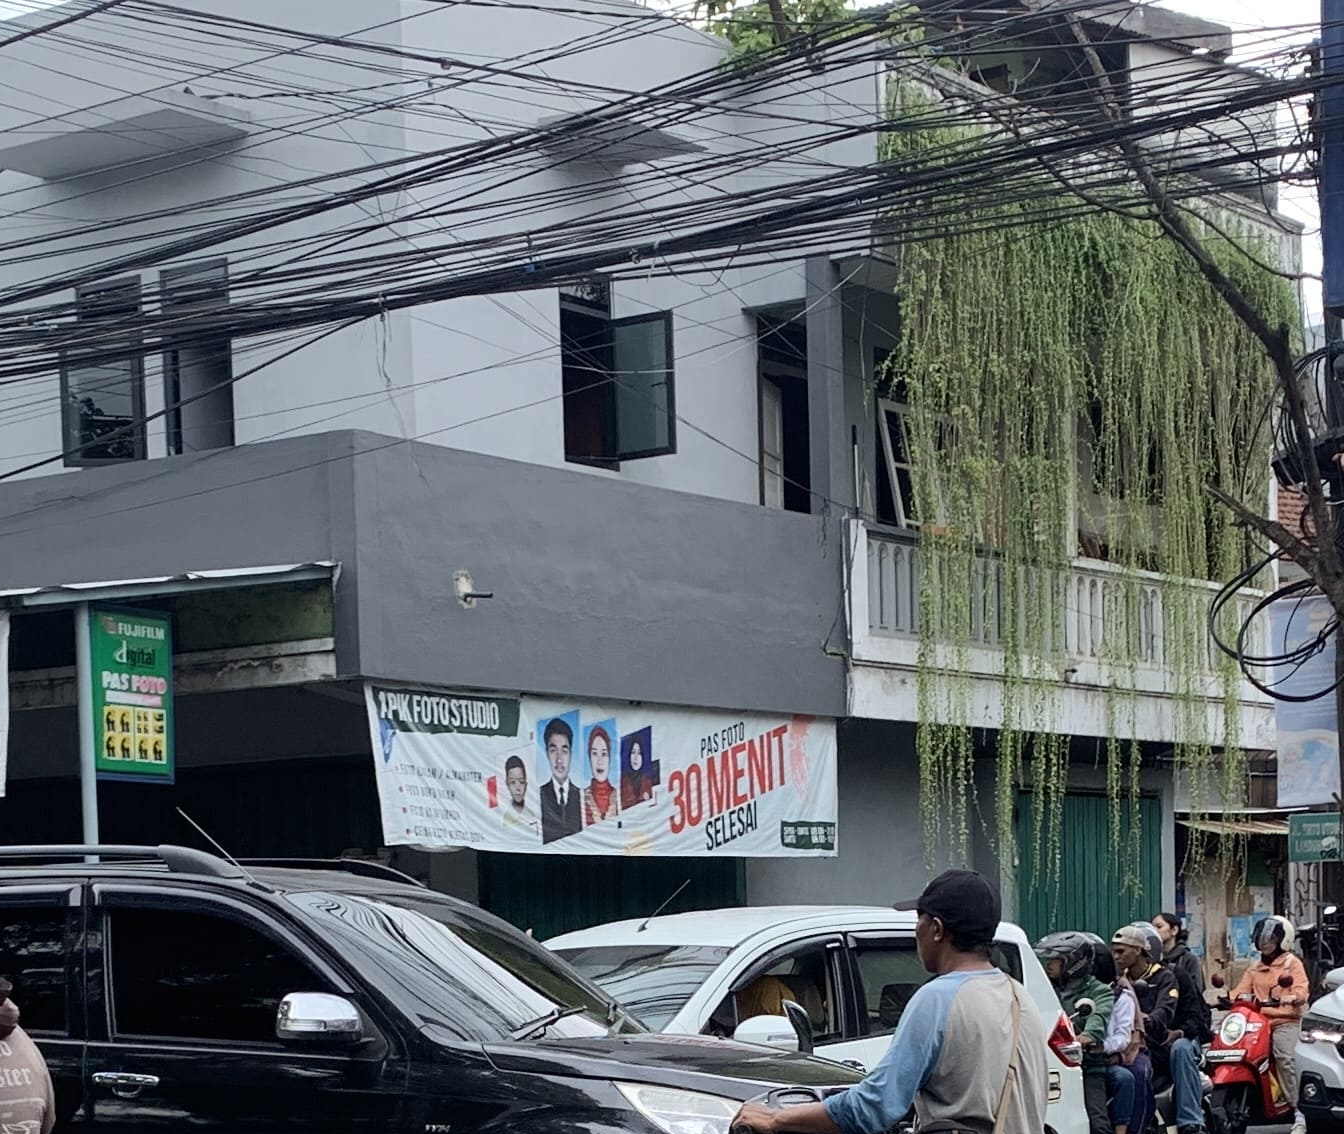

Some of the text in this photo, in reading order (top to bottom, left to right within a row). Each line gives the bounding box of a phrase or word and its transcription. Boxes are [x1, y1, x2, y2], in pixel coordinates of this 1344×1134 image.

[118, 622, 165, 640] FUJIFILM
[114, 639, 156, 667] digital
[101, 671, 168, 695] PAS FOTO
[413, 695, 450, 726] FOTO
[450, 699, 500, 730] STUDIO
[700, 721, 746, 759] PAS FOTO
[668, 724, 788, 835] 30 MENIT
[705, 800, 759, 851] SELESAI
